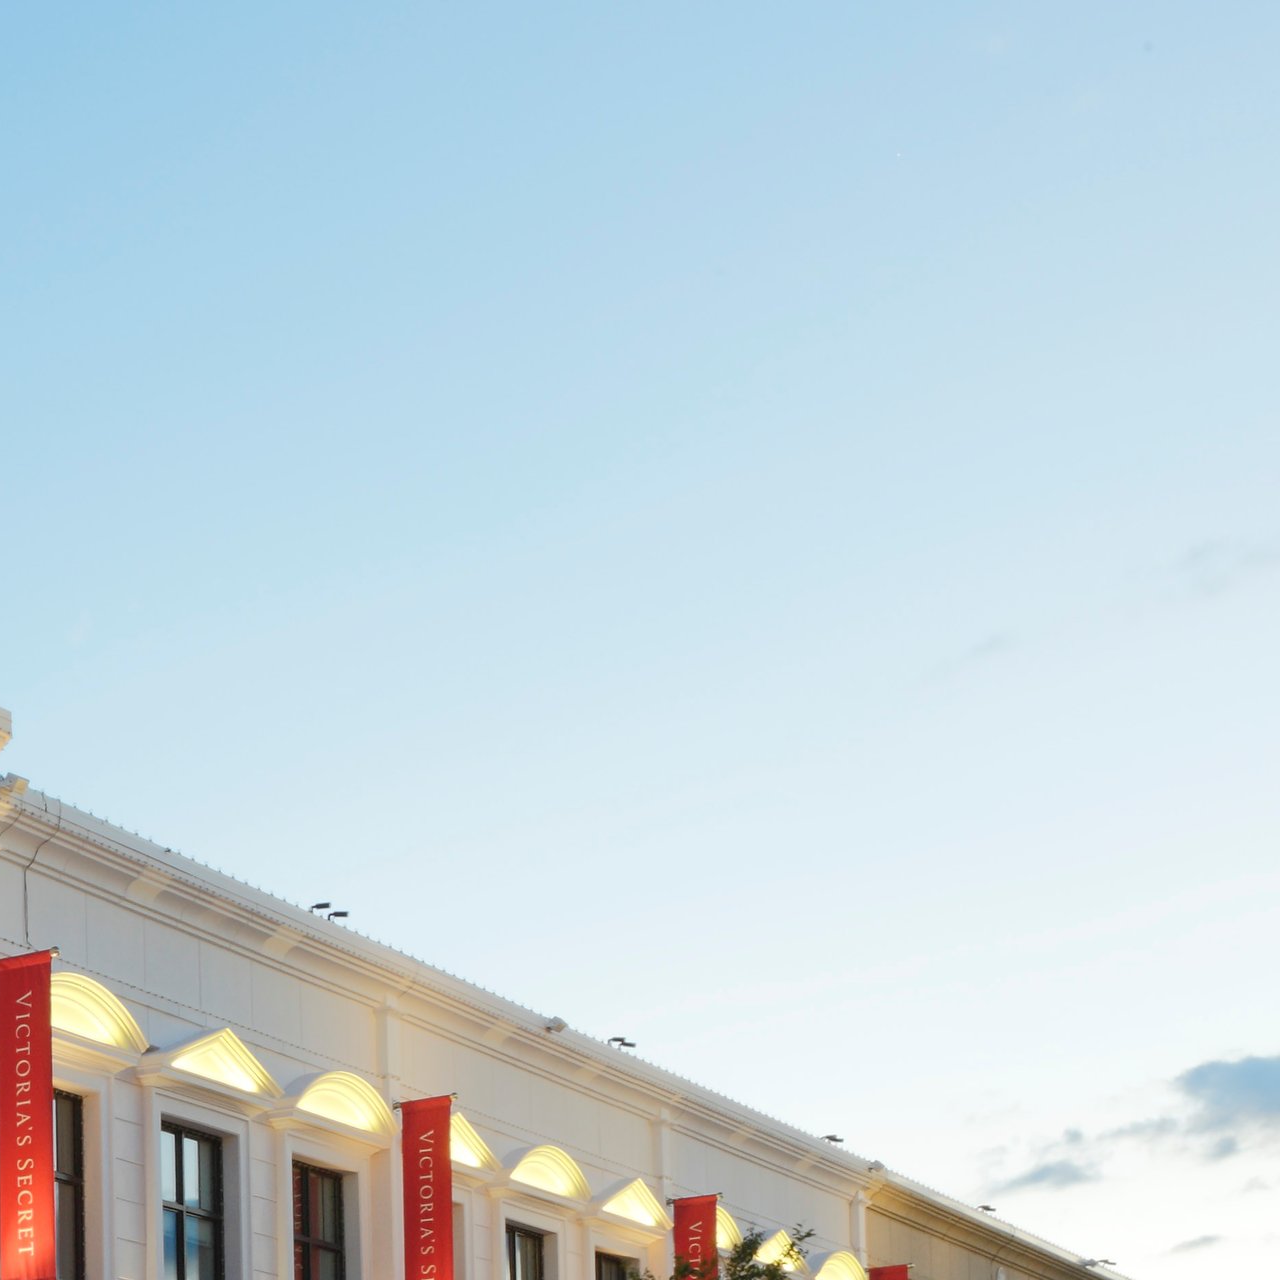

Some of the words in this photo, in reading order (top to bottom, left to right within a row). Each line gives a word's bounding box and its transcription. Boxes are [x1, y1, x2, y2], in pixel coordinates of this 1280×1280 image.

[14, 989, 33, 1147] VICTORIA'S
[16, 1157, 35, 1257] SECRET
[418, 1129, 435, 1256] VICTORIA'S
